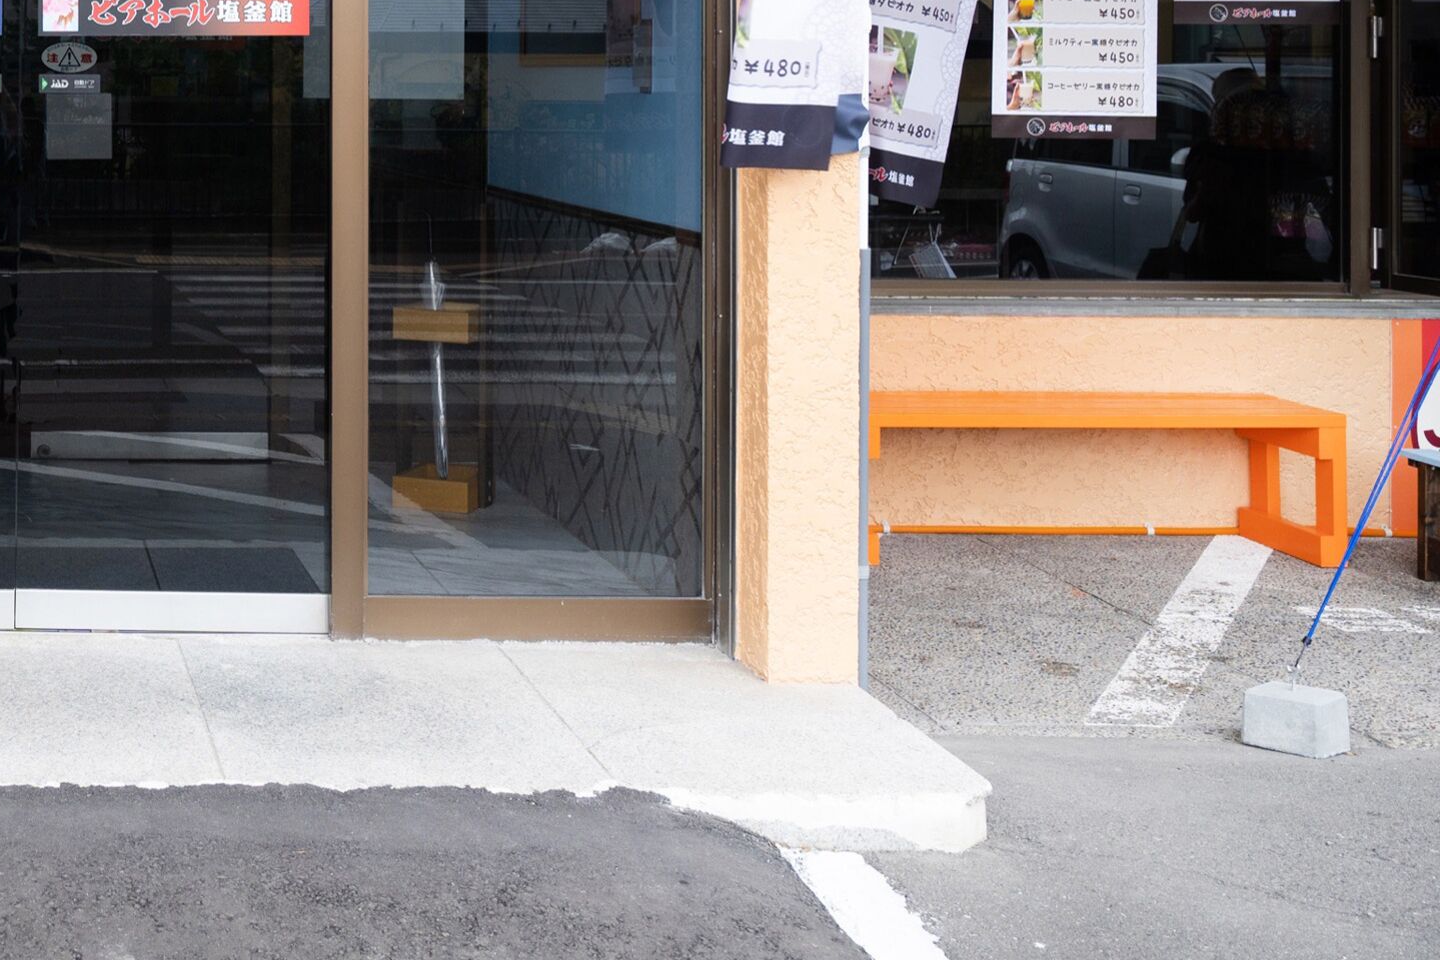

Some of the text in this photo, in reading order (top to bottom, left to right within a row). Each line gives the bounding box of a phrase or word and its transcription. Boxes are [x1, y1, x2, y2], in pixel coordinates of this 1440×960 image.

[1099, 8, 1136, 20] ¥450
[1098, 52, 1135, 64] ¥450
[744, 58, 802, 78] ¥480
[1098, 96, 1134, 108] ¥480
[897, 122, 932, 139] ¥480
